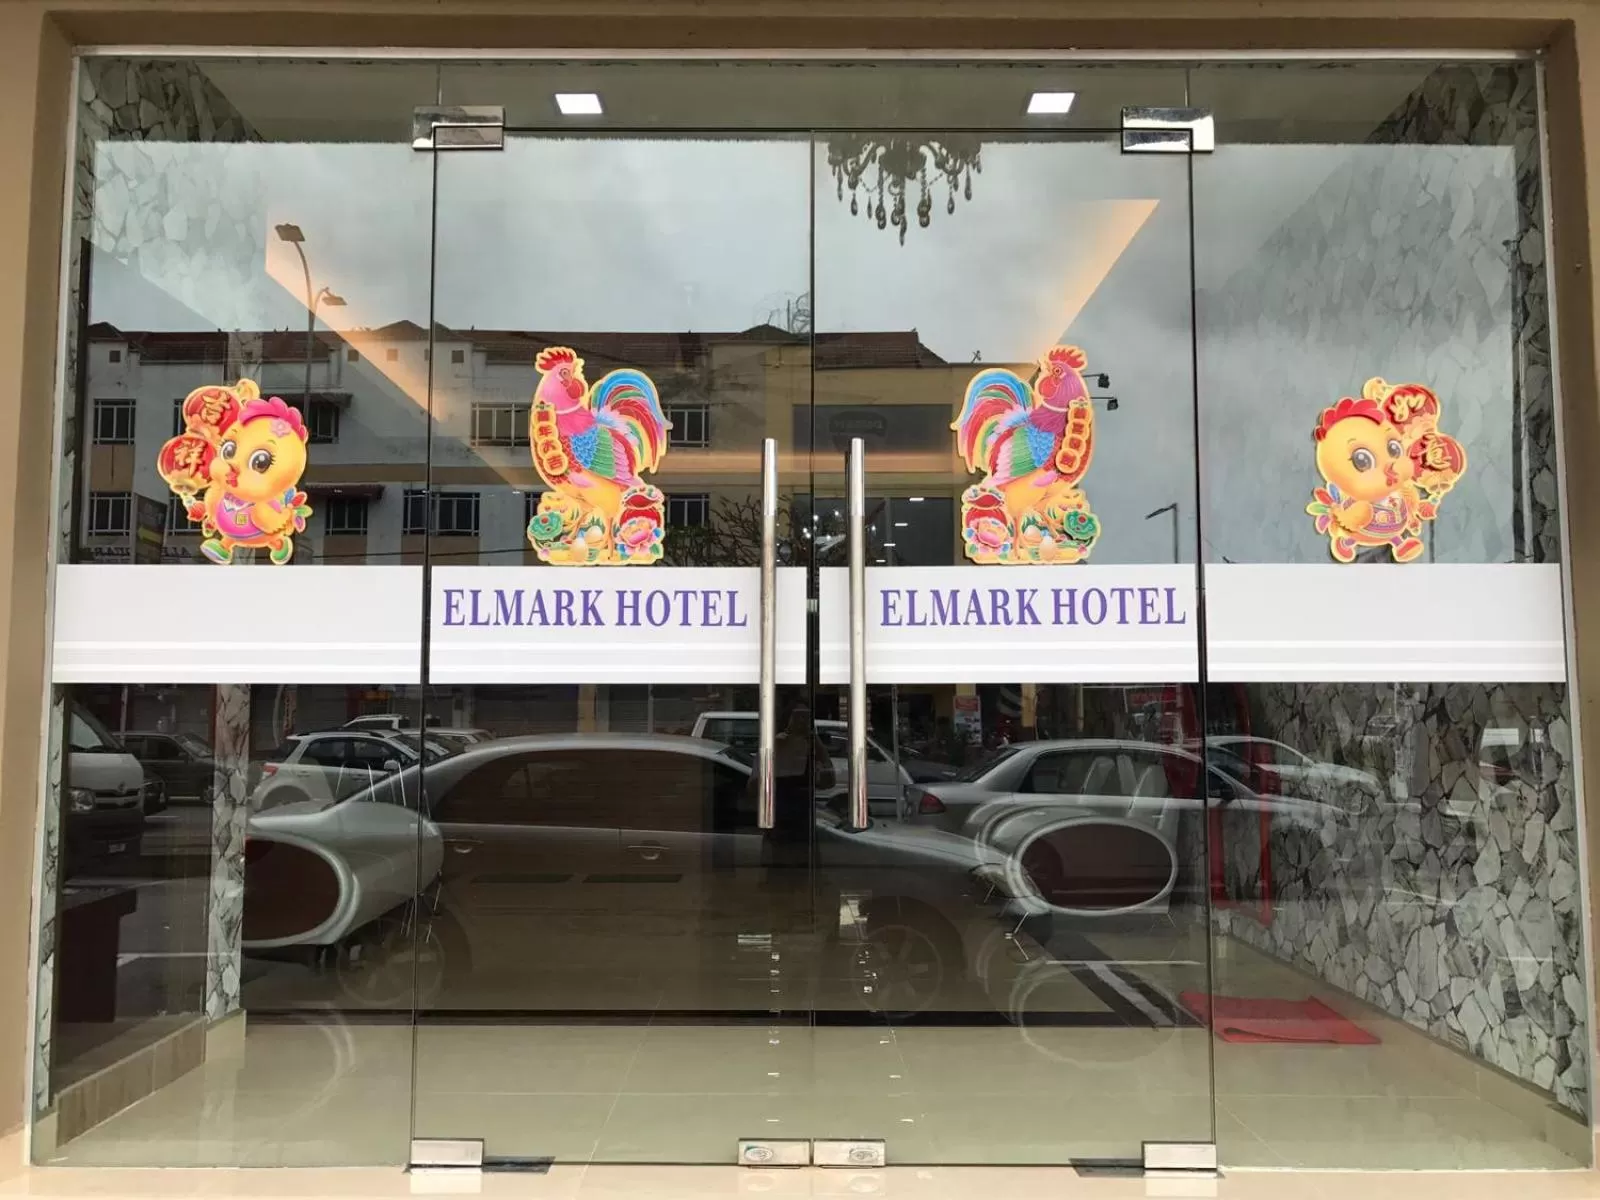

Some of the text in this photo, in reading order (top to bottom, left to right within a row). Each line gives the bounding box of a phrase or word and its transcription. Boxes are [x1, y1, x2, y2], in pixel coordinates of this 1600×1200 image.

[443, 588, 748, 627] ELMARK HOTEL
[880, 587, 1187, 626] ELMARK HOTEL
